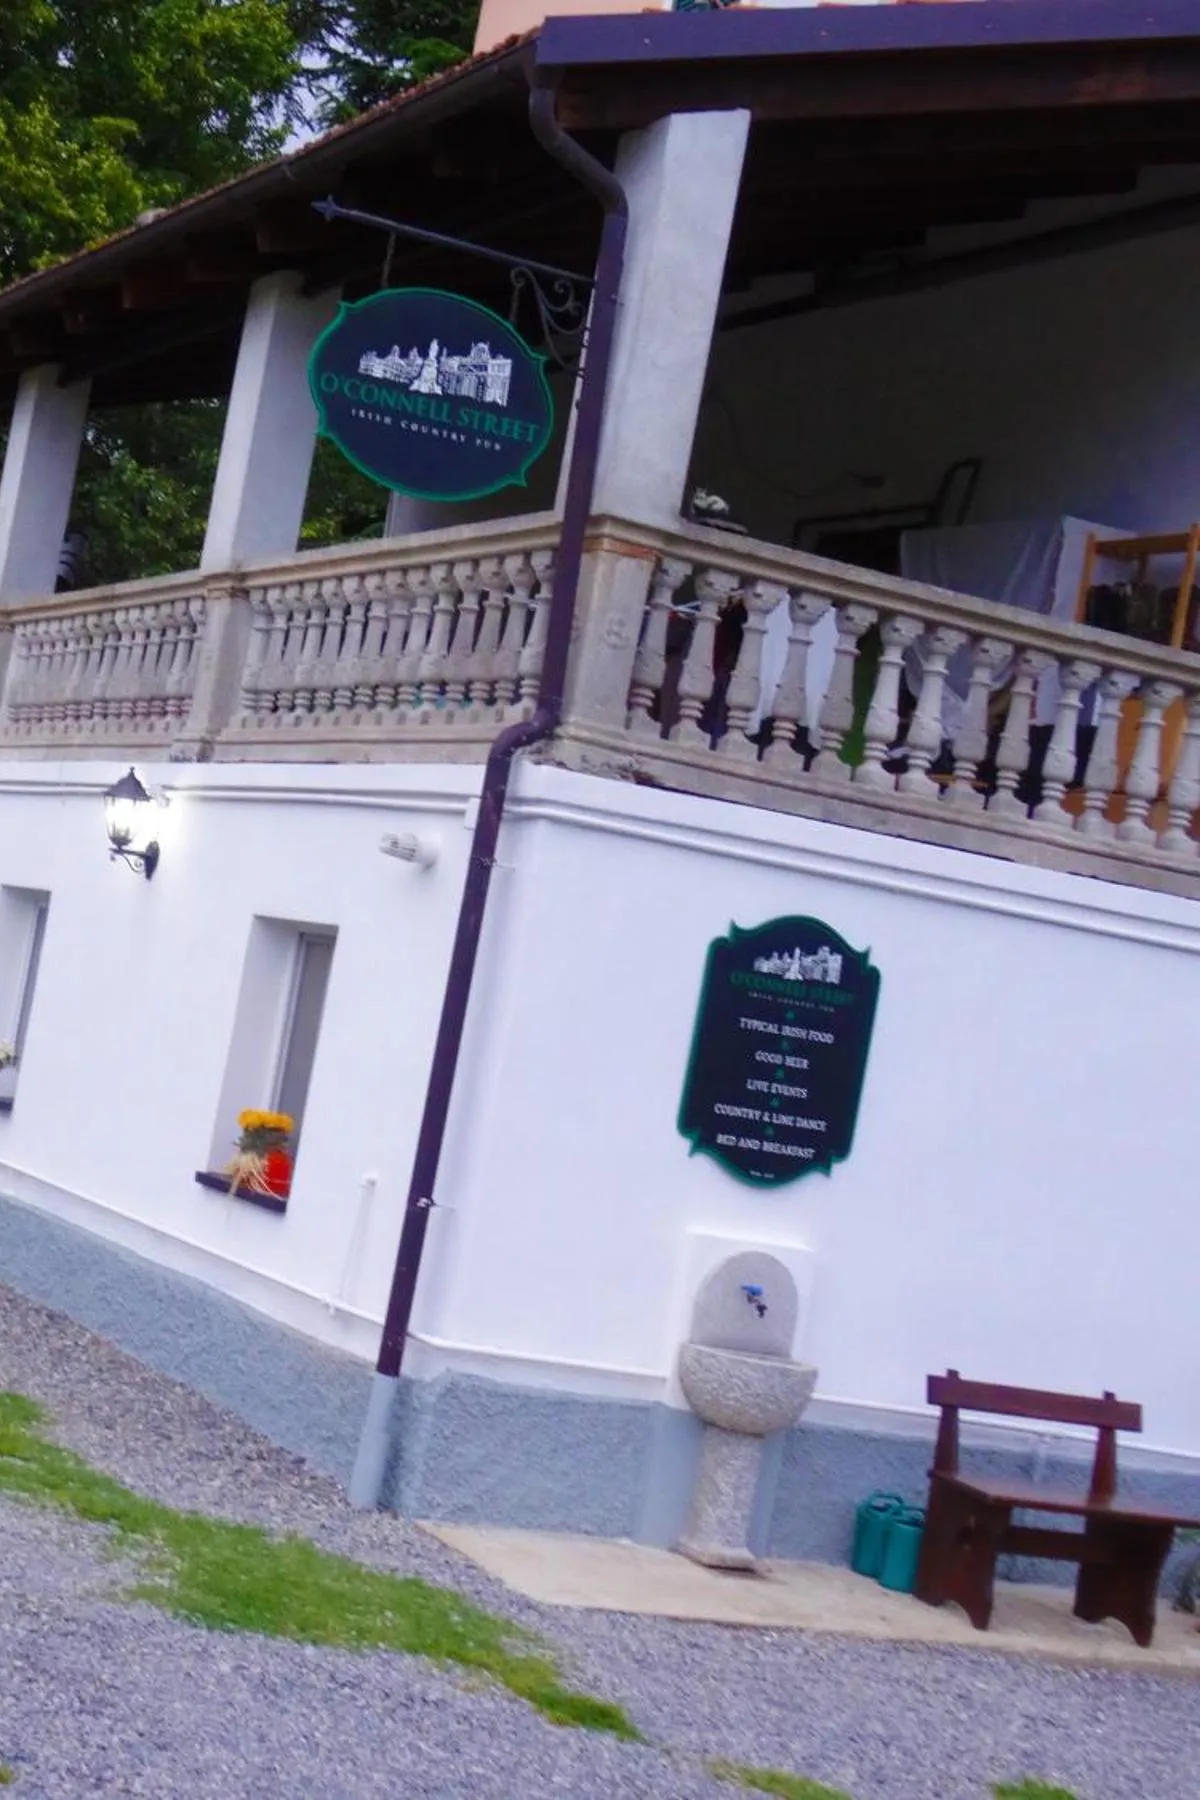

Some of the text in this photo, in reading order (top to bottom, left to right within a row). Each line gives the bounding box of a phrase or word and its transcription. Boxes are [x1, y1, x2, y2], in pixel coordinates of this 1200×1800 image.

[320, 374, 540, 443] O'CONNELL STREET
[351, 408, 502, 451] IRISH COUNTRY PUB
[740, 1017, 835, 1044] TYPICAL IRISH FOOD
[755, 1050, 810, 1069] GOOD BEER
[746, 1078, 808, 1099] LIVE EVENTS
[714, 1103, 828, 1132] COUNTRY & LINE DANCE
[716, 1133, 816, 1159] BED AND BREAKFAST
